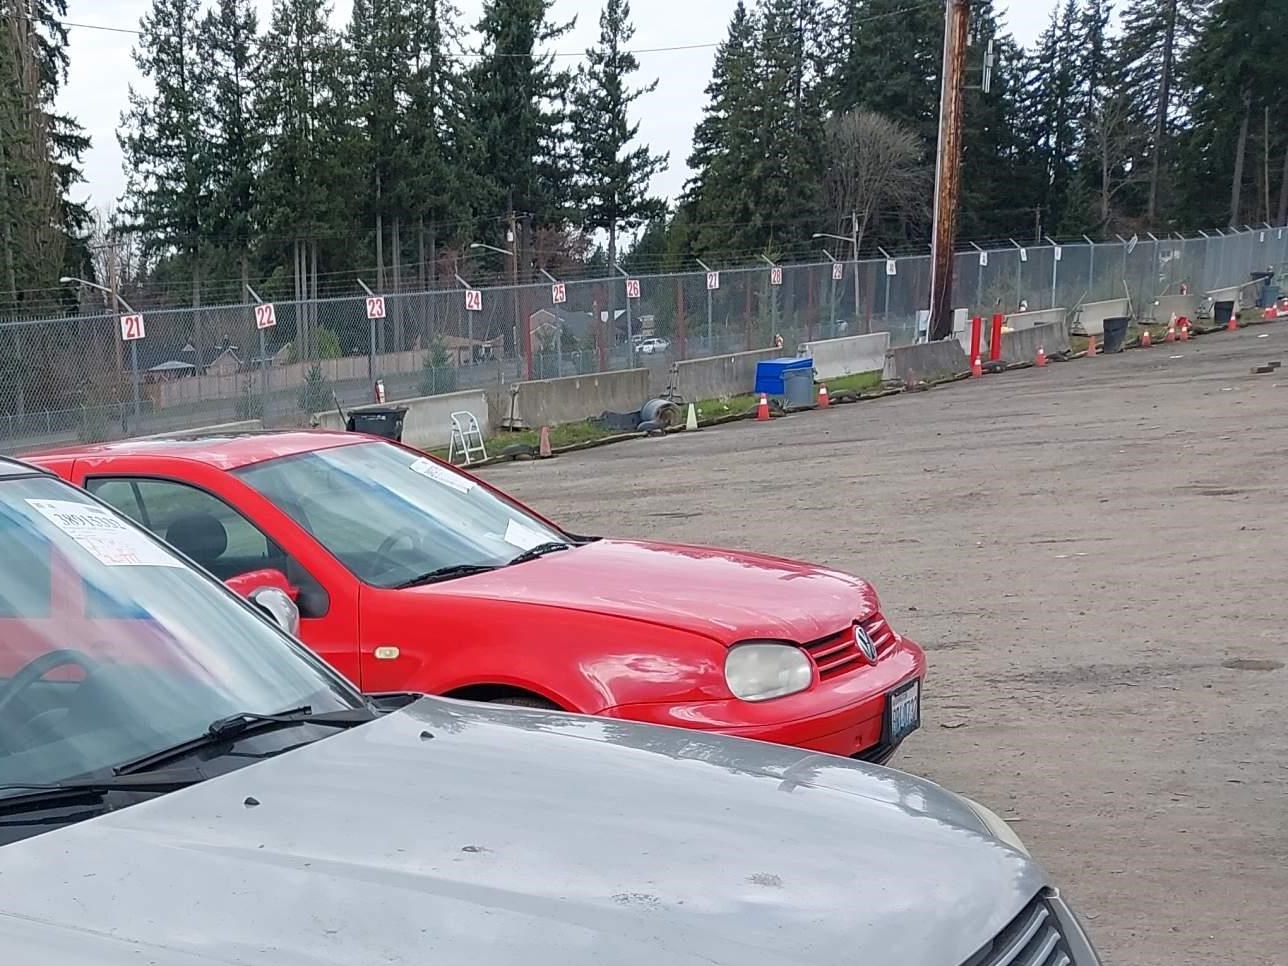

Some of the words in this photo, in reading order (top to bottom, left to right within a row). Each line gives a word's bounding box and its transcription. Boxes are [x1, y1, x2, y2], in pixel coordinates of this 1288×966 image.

[708, 273, 718, 288] 27
[772, 269, 781, 283] 28
[553, 285, 564, 301] 25
[627, 282, 639, 296] 26
[367, 298, 383, 317] 23
[467, 291, 481, 308] 24
[257, 305, 274, 326] 22
[125, 317, 141, 338] 21
